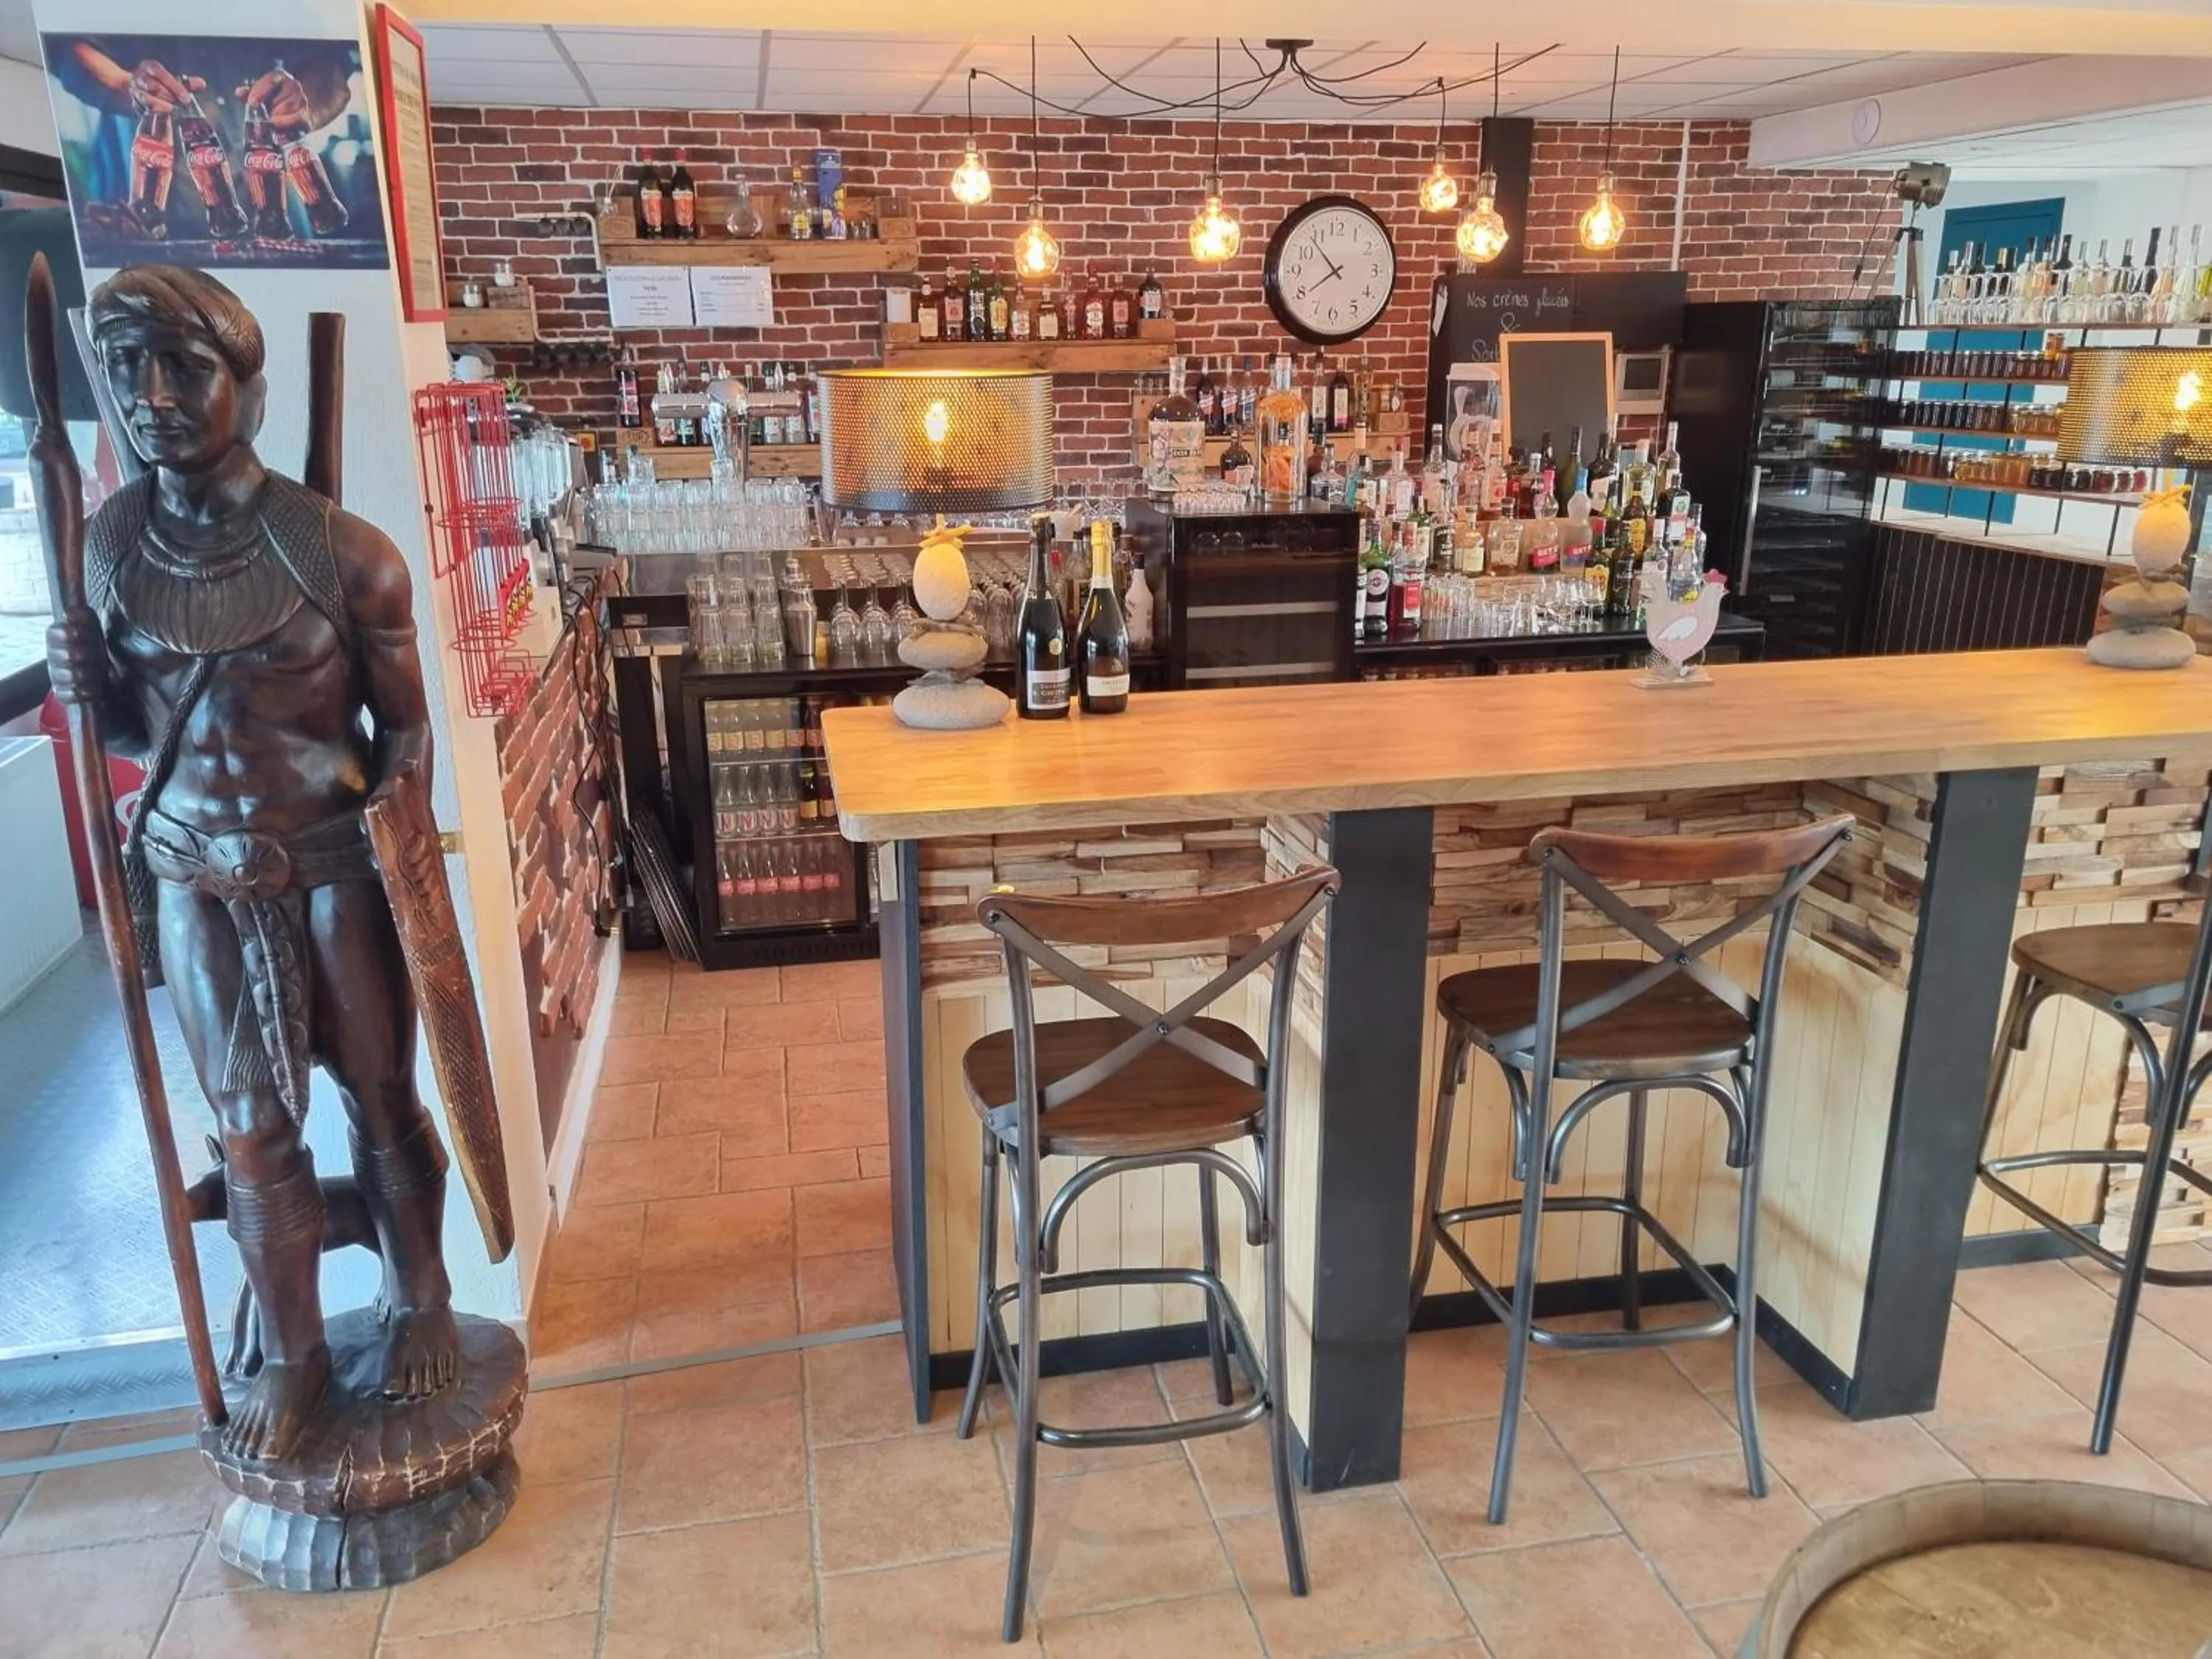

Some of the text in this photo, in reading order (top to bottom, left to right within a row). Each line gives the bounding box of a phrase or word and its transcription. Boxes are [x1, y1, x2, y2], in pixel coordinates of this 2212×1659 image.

[244, 151, 283, 169] Coca-Cola
[1312, 229, 1324, 243] 11
[1329, 221, 1344, 237] 12
[1353, 228, 1358, 242] 1
[1299, 246, 1313, 260] 10
[1363, 241, 1372, 256] 2
[1291, 264, 1301, 279] 9
[1371, 263, 1378, 278] 3
[1295, 285, 1306, 300] 8
[1362, 285, 1371, 298] 4
[1467, 290, 1487, 307] Nos
[1312, 300, 1321, 315] 7
[1328, 306, 1338, 321] 6
[1350, 300, 1358, 315] 5
